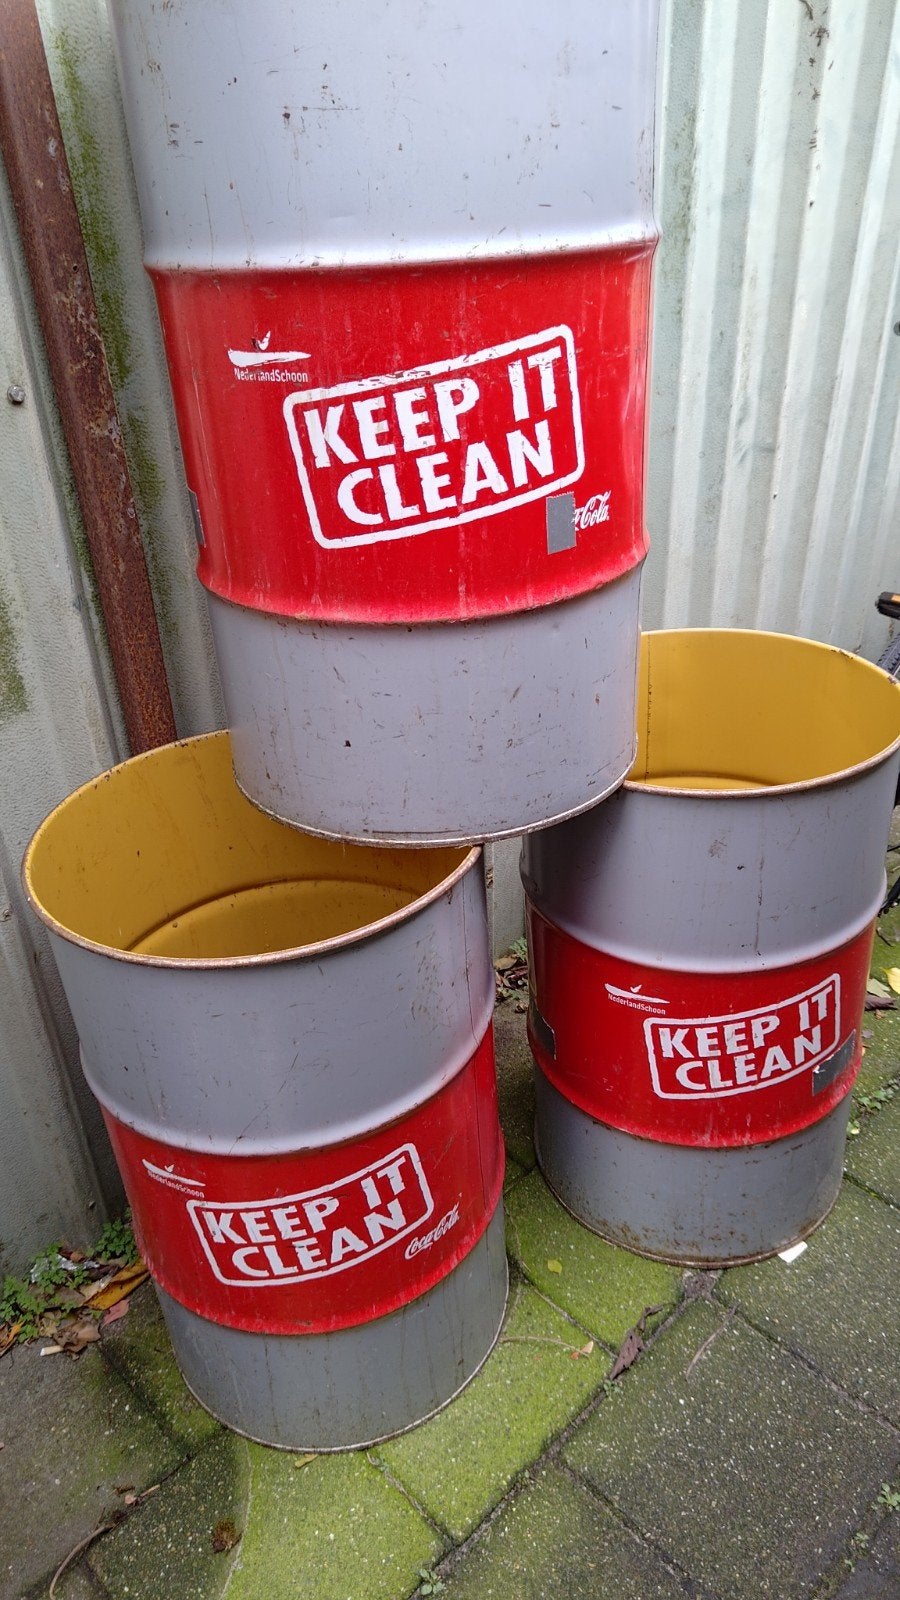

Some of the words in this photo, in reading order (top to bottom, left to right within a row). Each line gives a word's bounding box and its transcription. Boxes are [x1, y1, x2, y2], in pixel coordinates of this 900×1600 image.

[303, 377, 480, 469] KEEP
[507, 345, 562, 423] IT
[337, 419, 555, 526] CLEAN
[607, 993, 666, 1015] NederlandSchoon
[658, 1015, 780, 1059] KEEP
[799, 984, 833, 1032] IT
[675, 1024, 822, 1091] CLEAN
[201, 1196, 340, 1244] KEEP
[360, 1155, 406, 1210] IT
[231, 1198, 407, 1277] CLEAN
